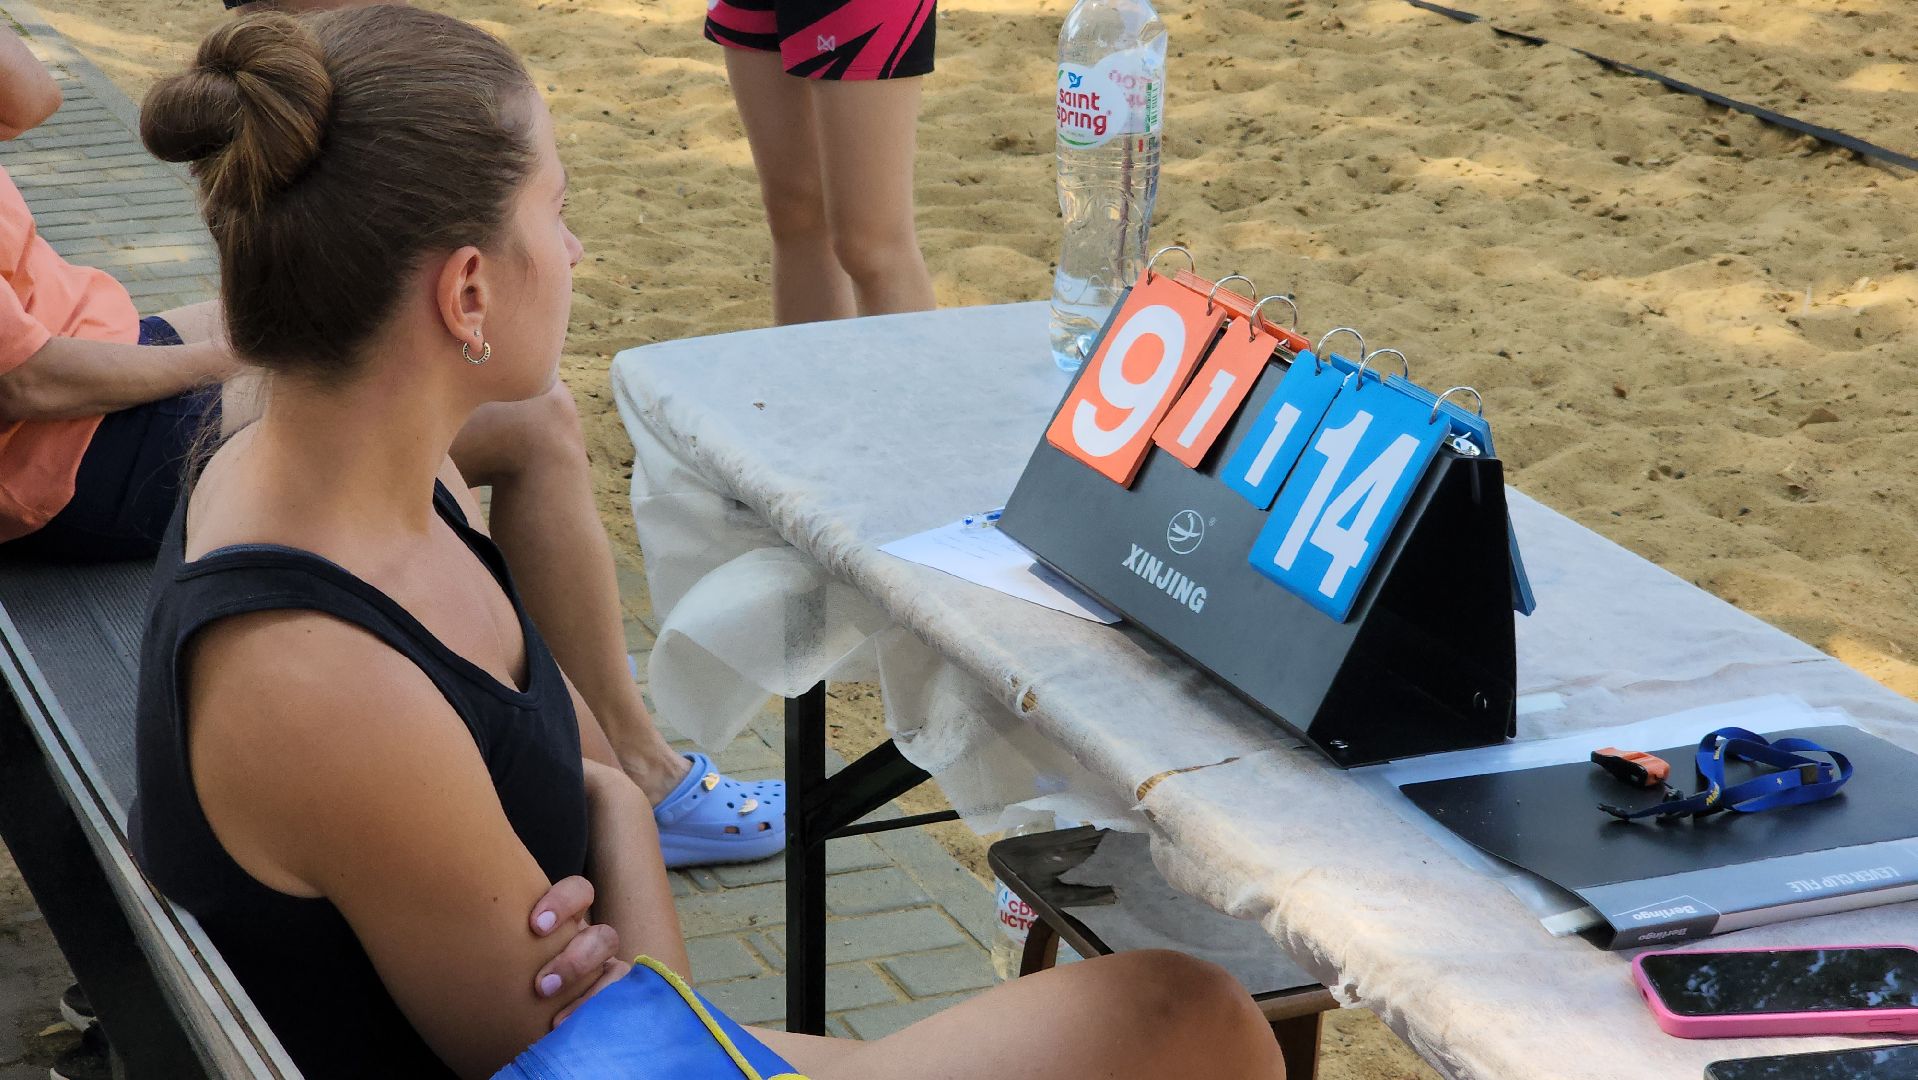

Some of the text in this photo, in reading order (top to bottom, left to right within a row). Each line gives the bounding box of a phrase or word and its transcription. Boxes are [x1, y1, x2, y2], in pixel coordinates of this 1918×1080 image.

[1056, 104, 1107, 136] spring
[1059, 88, 1101, 111] saint
[1072, 304, 1187, 457] 9
[1176, 369, 1237, 448] 1
[1243, 402, 1302, 487] 1
[1273, 410, 1421, 599] 14
[1121, 542, 1208, 615] XINJING
[1785, 866, 1901, 893] LEVER CLIP FILE
[1632, 905, 1698, 921] Berlingo
[1638, 927, 1688, 941] Berlingo
